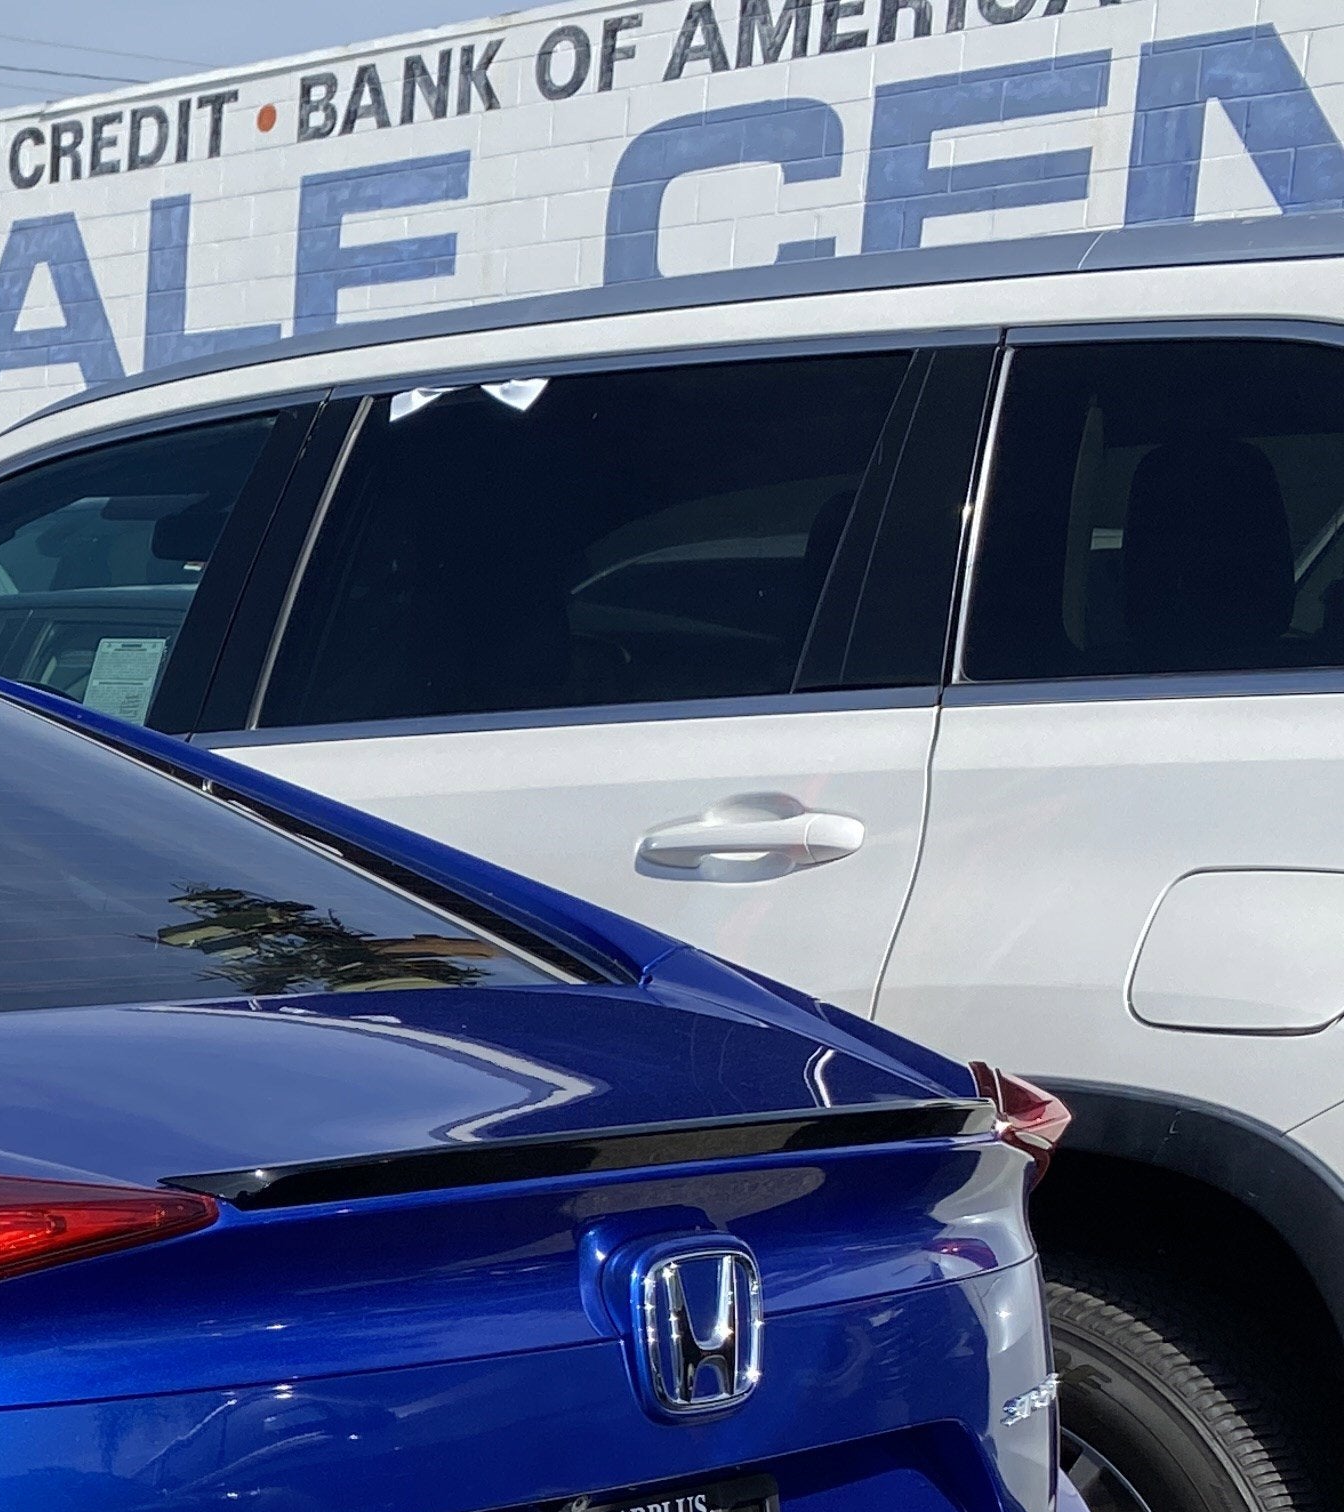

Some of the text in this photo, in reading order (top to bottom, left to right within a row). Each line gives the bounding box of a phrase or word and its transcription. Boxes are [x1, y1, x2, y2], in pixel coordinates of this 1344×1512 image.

[7, 89, 240, 190] CREDIT
[296, 38, 506, 144] BANK
[534, 12, 644, 101] OF
